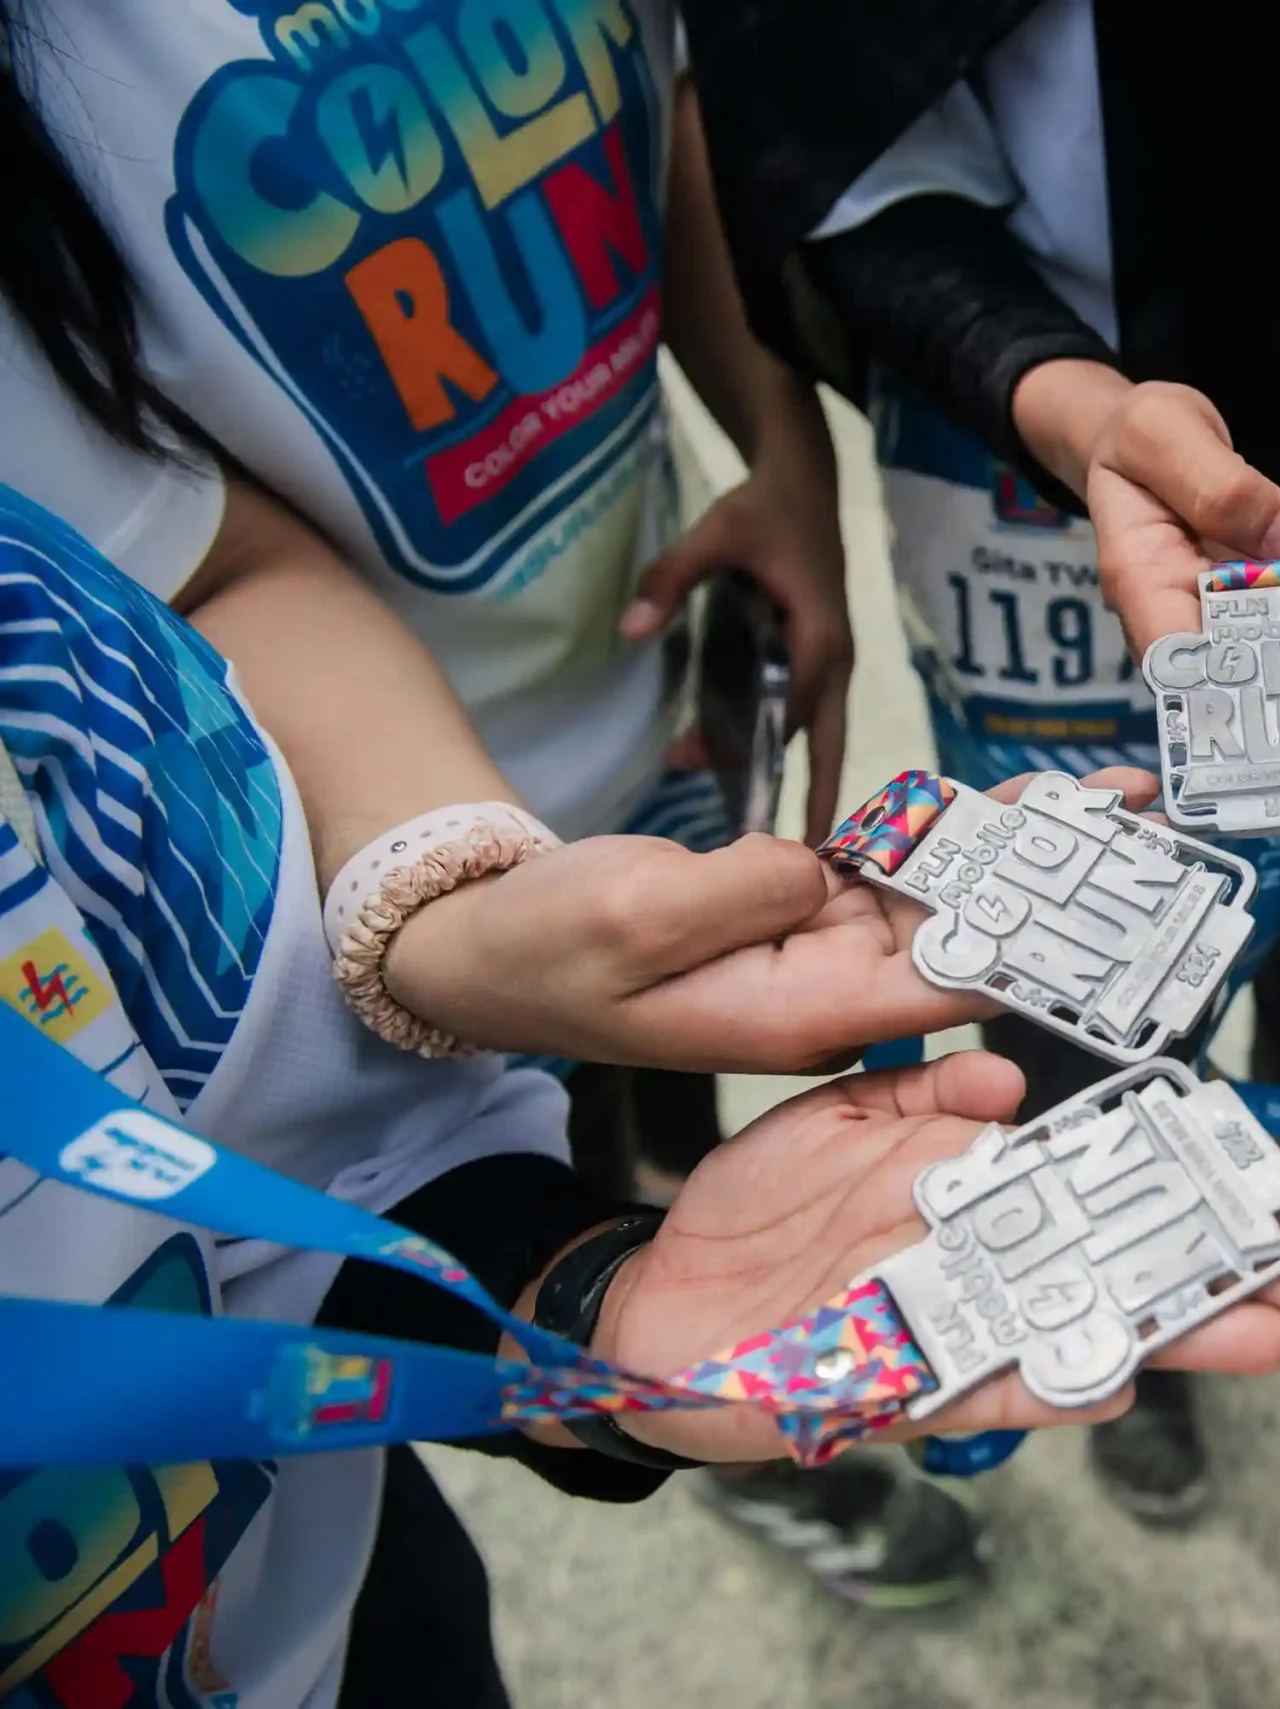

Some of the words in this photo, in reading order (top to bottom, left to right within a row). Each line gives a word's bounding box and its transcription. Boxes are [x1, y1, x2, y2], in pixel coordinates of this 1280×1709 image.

[344, 115, 649, 431] RUN
[465, 412, 543, 488] COLOR
[541, 362, 611, 420] YOUR
[948, 572, 1134, 687] 119
[1210, 598, 1268, 619] PLN
[904, 837, 961, 893] PLN
[920, 771, 1122, 979] COLOR
[938, 808, 1027, 909] mobile
[1173, 884, 1206, 926] MILES
[1002, 846, 1190, 1001] RUN
[923, 1128, 1131, 1392] COLOR
[1049, 1106, 1225, 1315] RUN
[928, 1303, 988, 1373] PLN
[937, 1224, 1028, 1346] mobile
